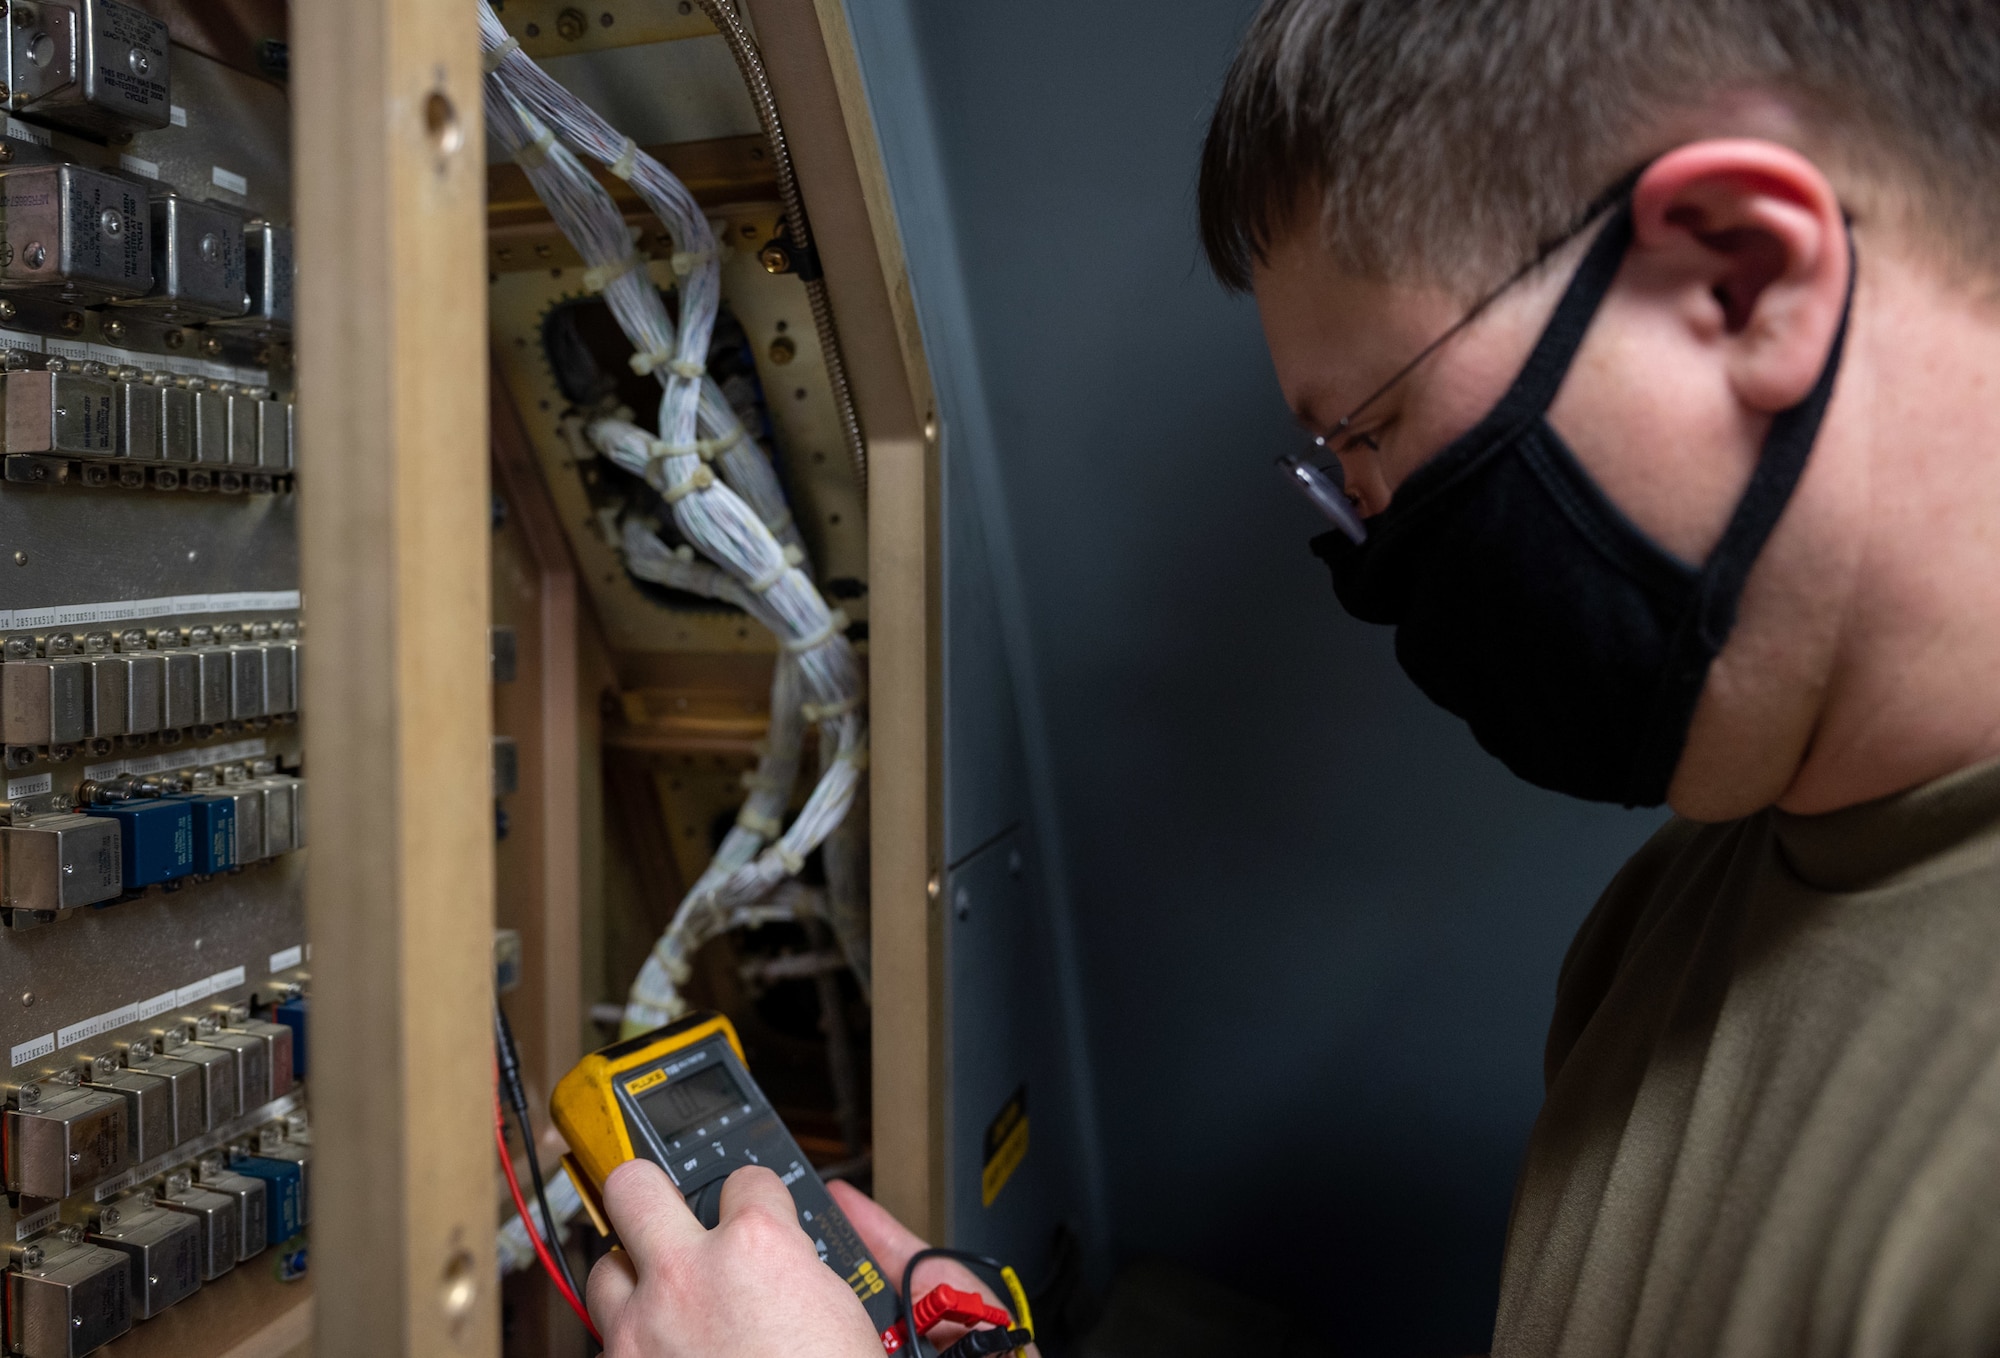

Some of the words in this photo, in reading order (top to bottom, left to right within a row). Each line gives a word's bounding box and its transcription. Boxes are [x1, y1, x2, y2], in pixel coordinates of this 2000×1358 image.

[101, 67, 115, 78] THIS
[117, 72, 136, 85] RELAY
[125, 91, 148, 105] CYCLES
[684, 1158, 698, 1171] OFF
